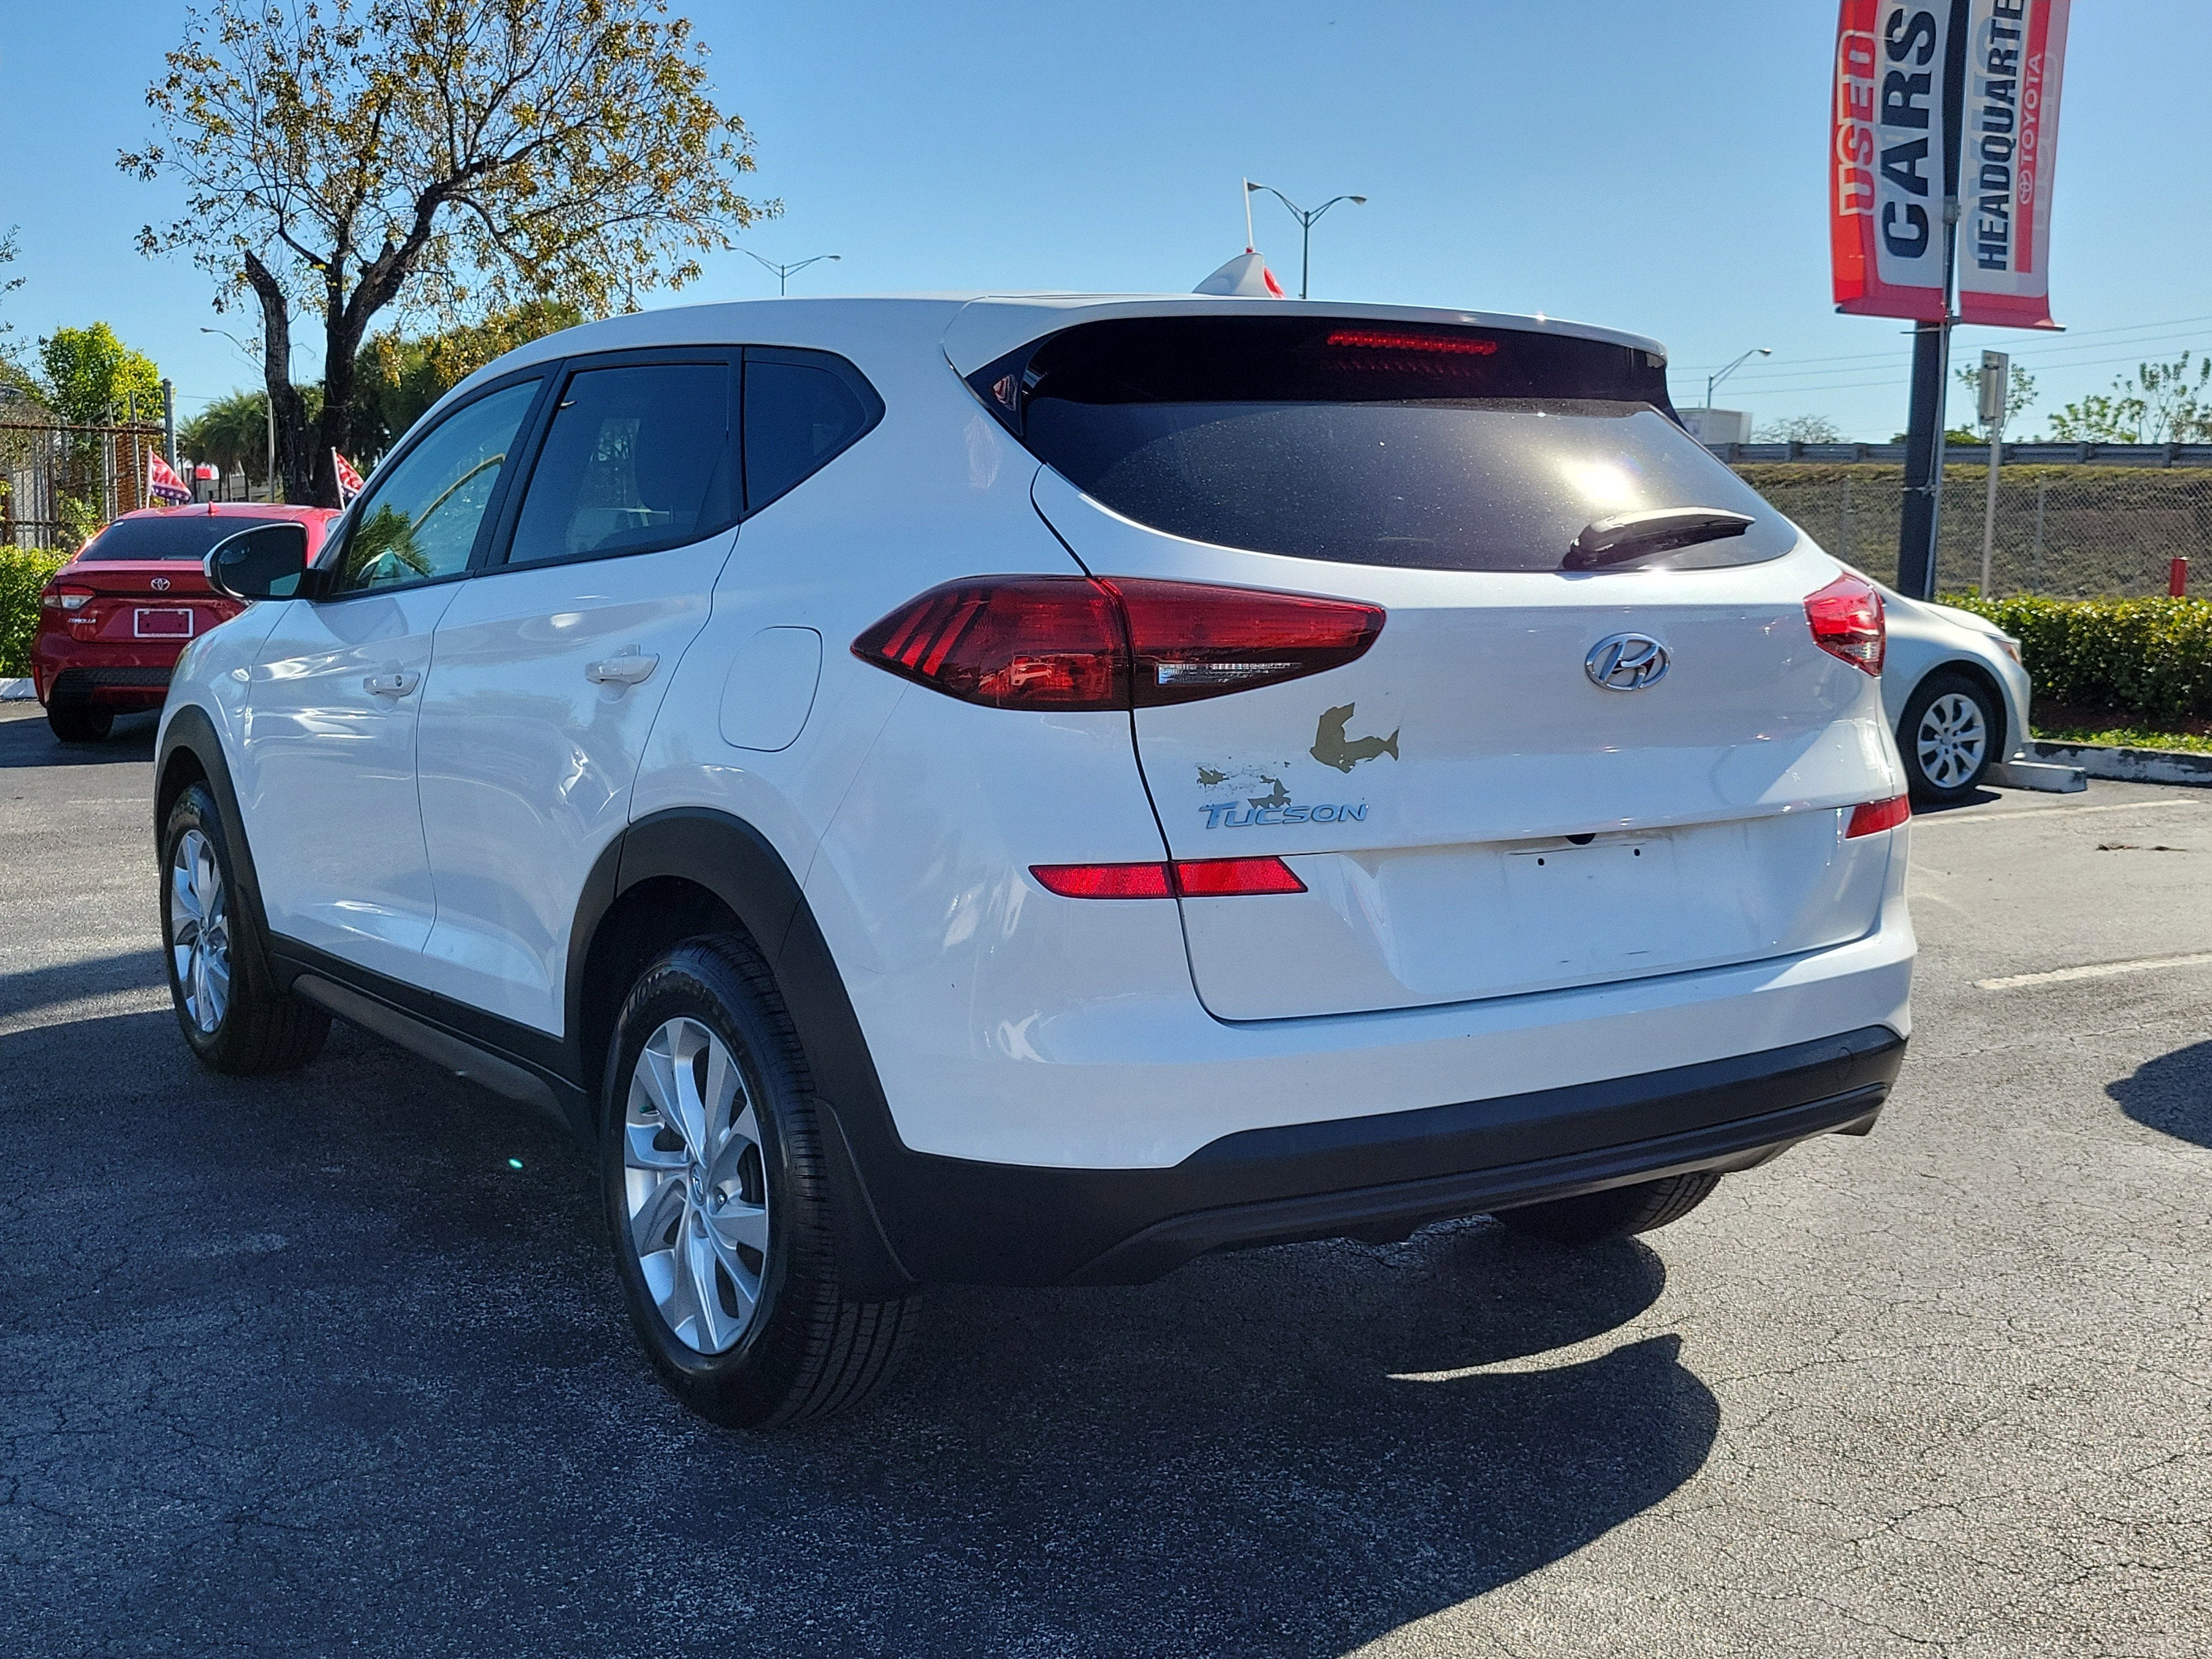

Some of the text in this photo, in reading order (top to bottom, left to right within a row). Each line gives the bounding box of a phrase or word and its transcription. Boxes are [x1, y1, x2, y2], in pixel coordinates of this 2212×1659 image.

[1837, 30, 1876, 216] USED
[1880, 8, 1936, 259] CARS
[2020, 53, 2042, 166] TOYOTA
[1199, 800, 1368, 829] TUCSON
